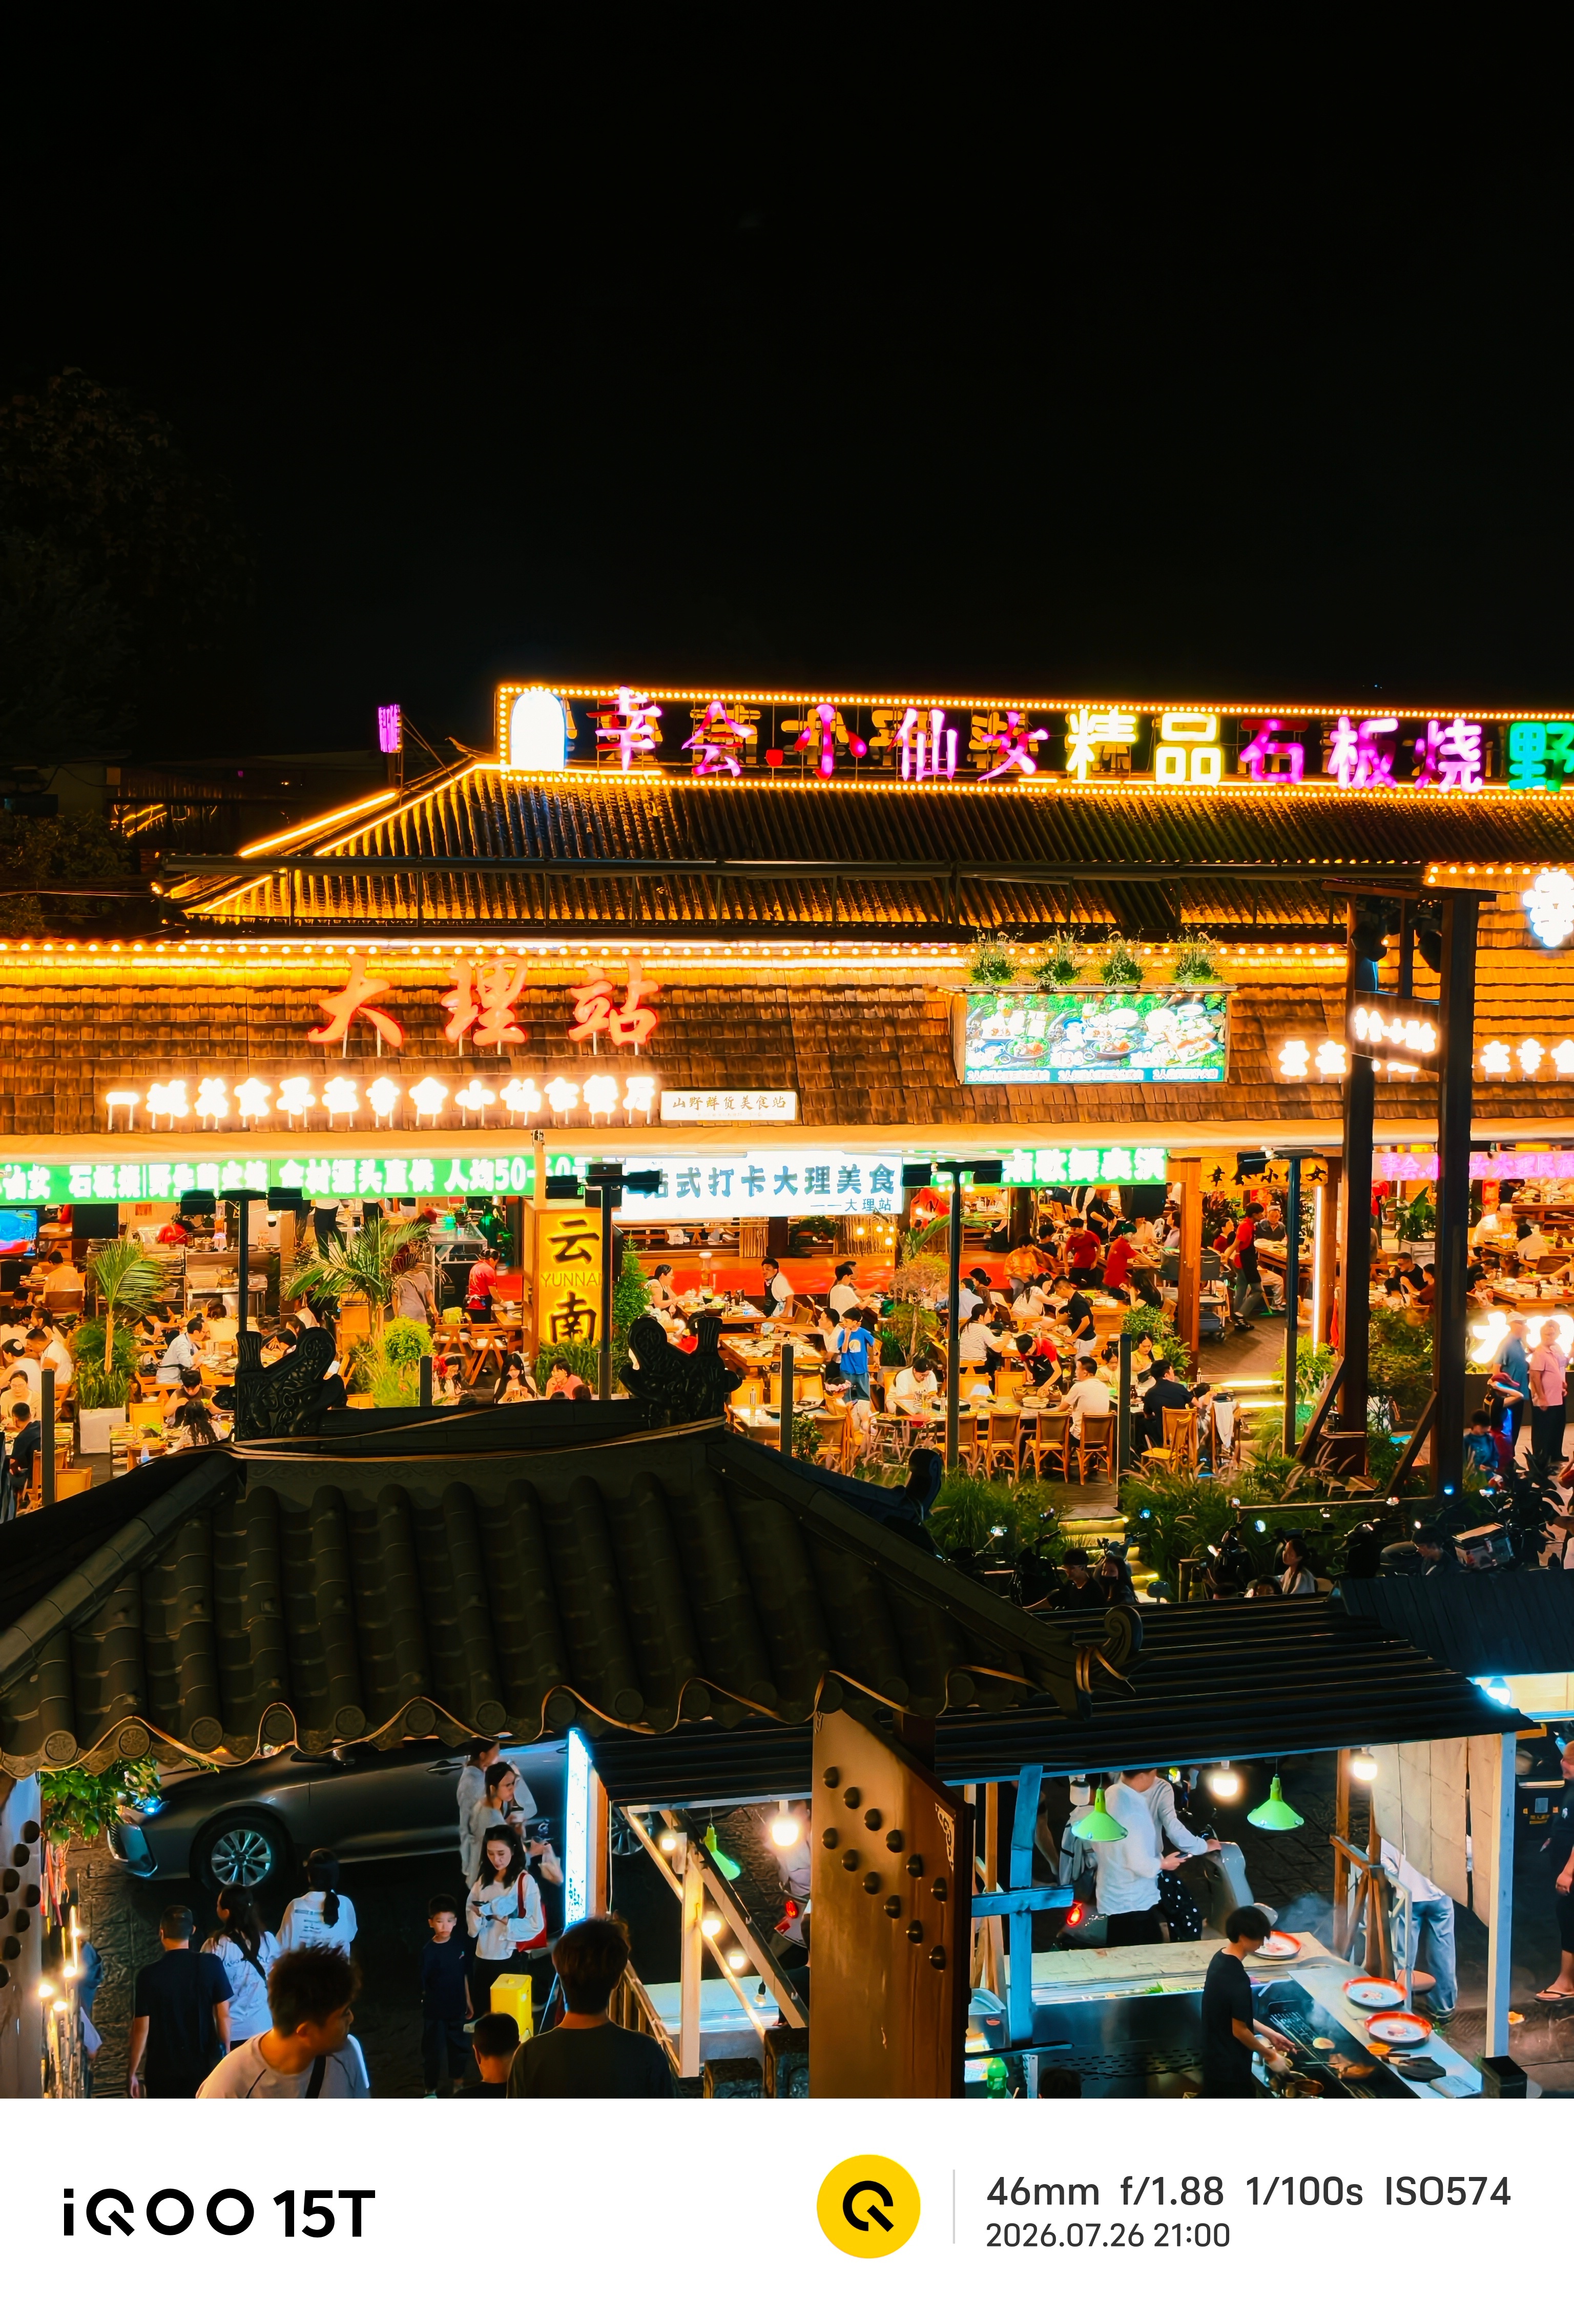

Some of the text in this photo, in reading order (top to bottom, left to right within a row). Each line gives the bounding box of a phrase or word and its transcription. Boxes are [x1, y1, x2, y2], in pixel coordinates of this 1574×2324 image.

[308, 954, 659, 1047] 大理站
[673, 1095, 786, 1111] 山野鲜货美食站
[0, 1164, 50, 1199] 仙女
